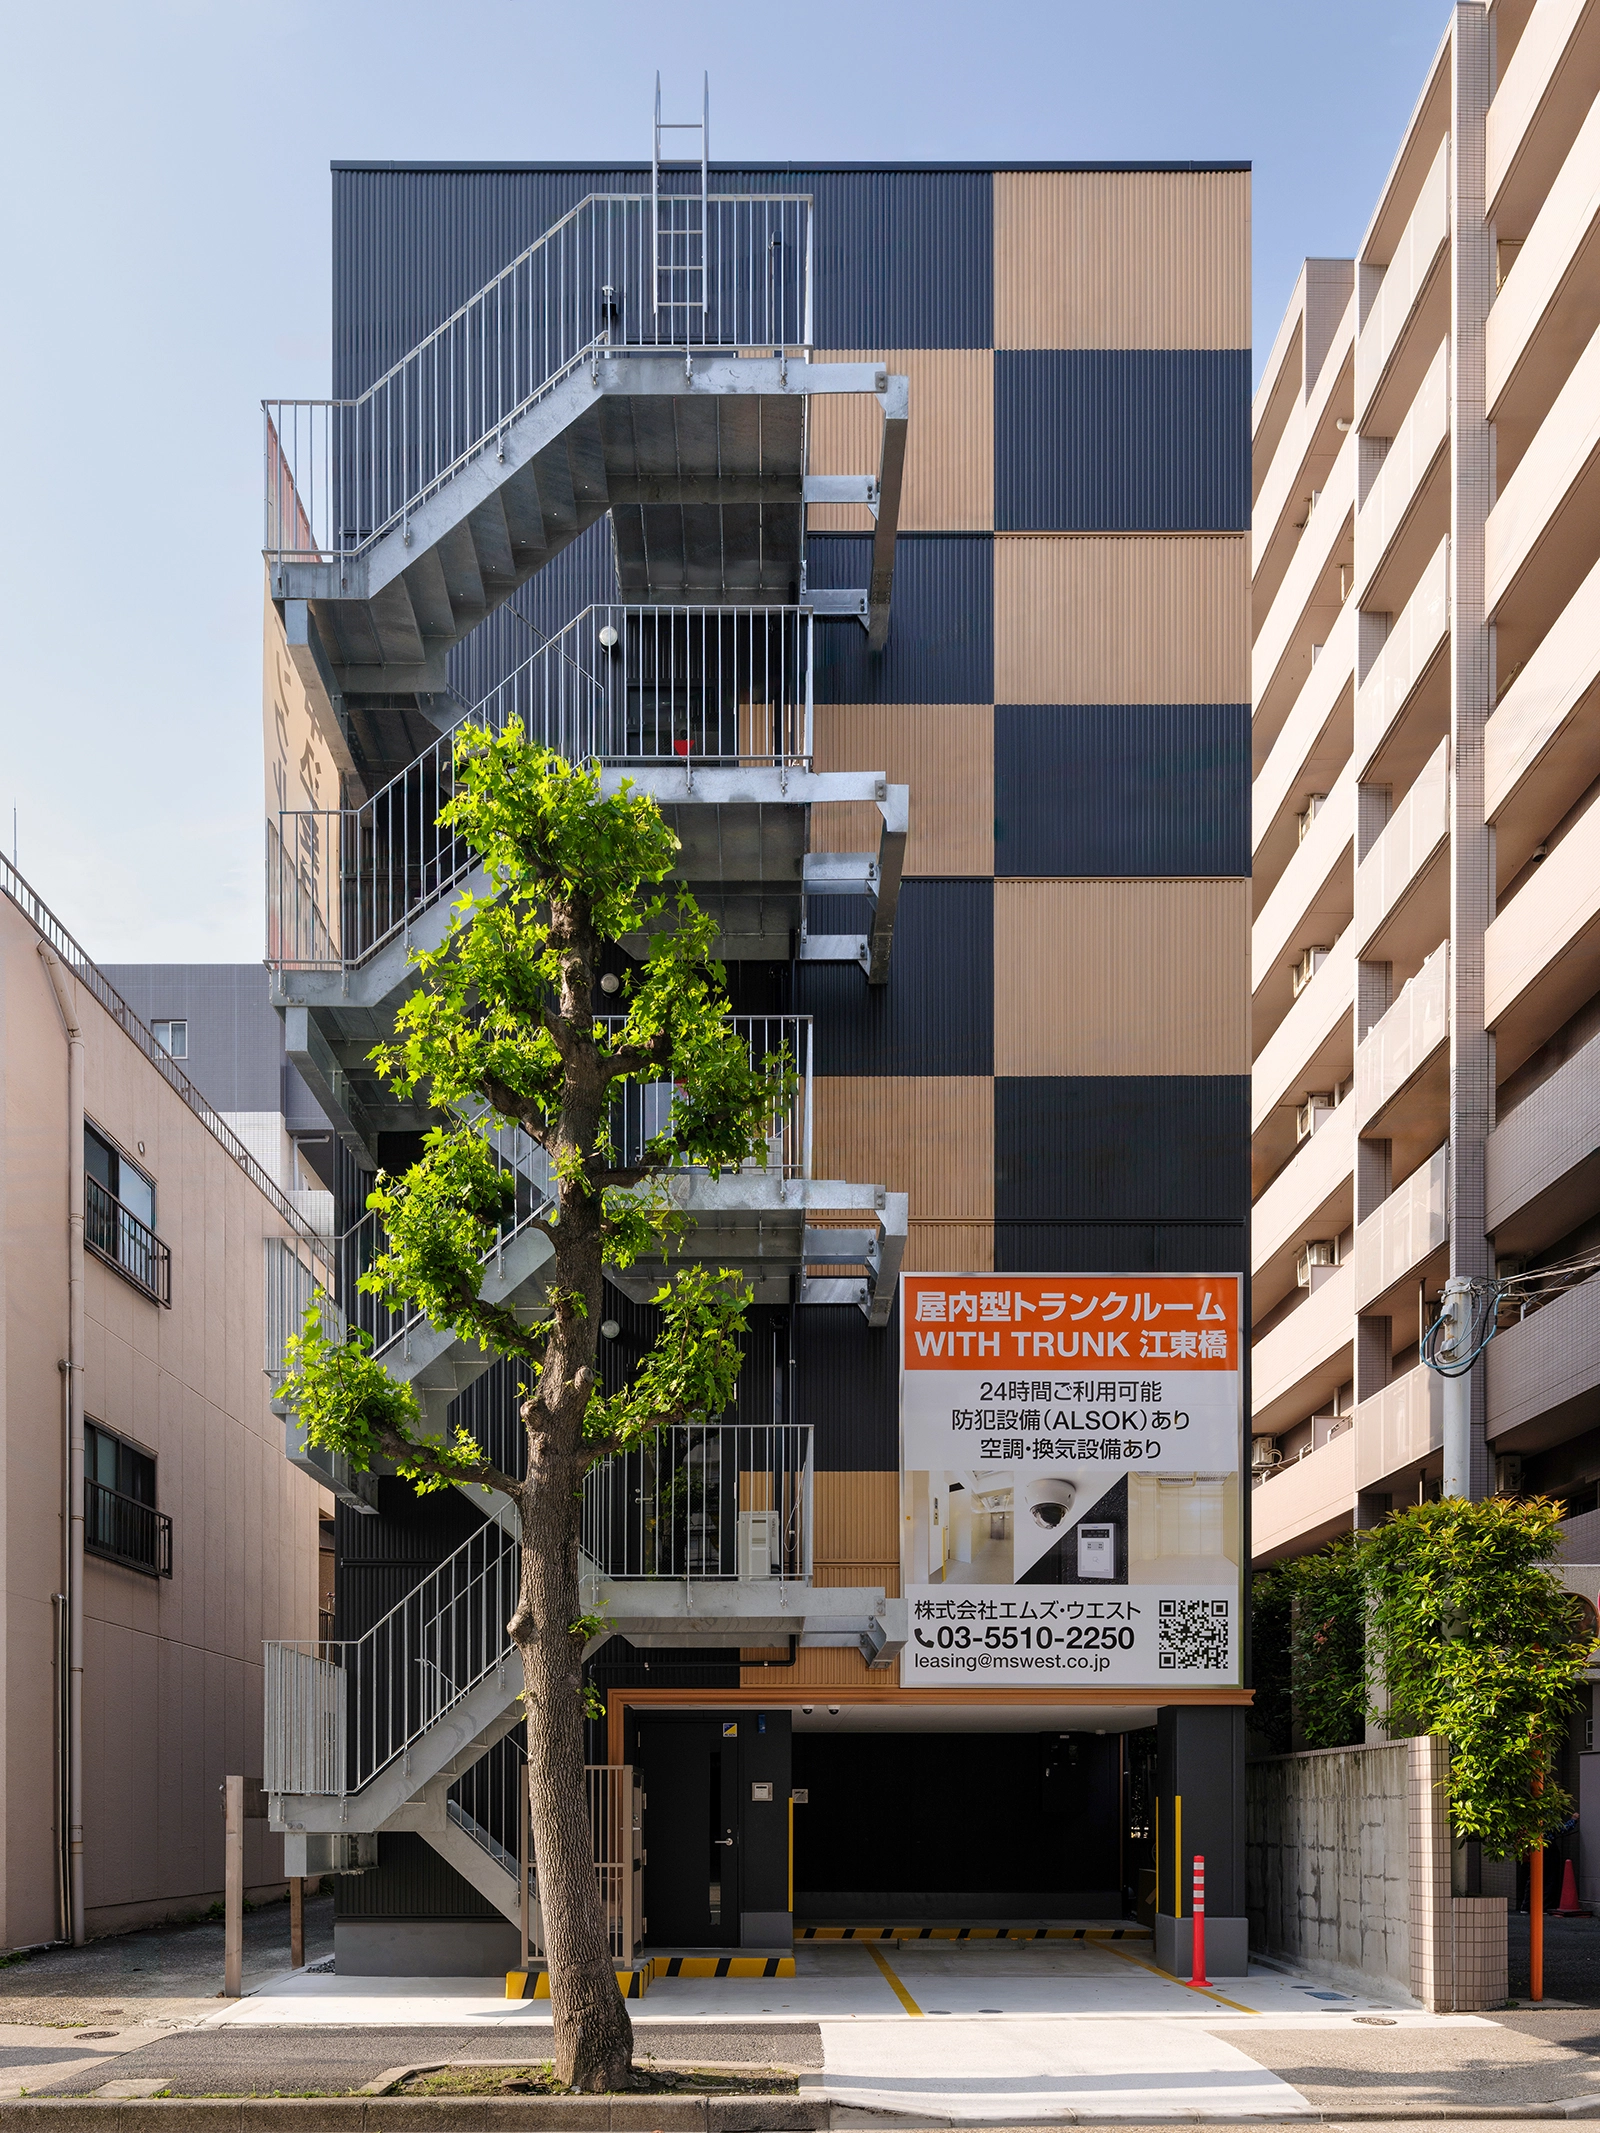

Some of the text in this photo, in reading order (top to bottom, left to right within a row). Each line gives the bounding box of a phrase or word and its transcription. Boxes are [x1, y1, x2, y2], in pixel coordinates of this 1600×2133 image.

[915, 1290, 1227, 1322] 屋内型トランクルーム
[915, 1329, 1228, 1358] WITH TRUNK 江東橋
[980, 1380, 1162, 1402] 24時間ご利用可能
[952, 1409, 1189, 1432] 防犯設備(ALSOK)あり
[980, 1438, 1161, 1459] 空調・換気設備あり
[914, 1600, 1141, 1621] 株式会社エムズ・ウエスト
[937, 1626, 1135, 1649] 03-5510-2250
[915, 1653, 1111, 1672] leasing@mswest.co.jp
